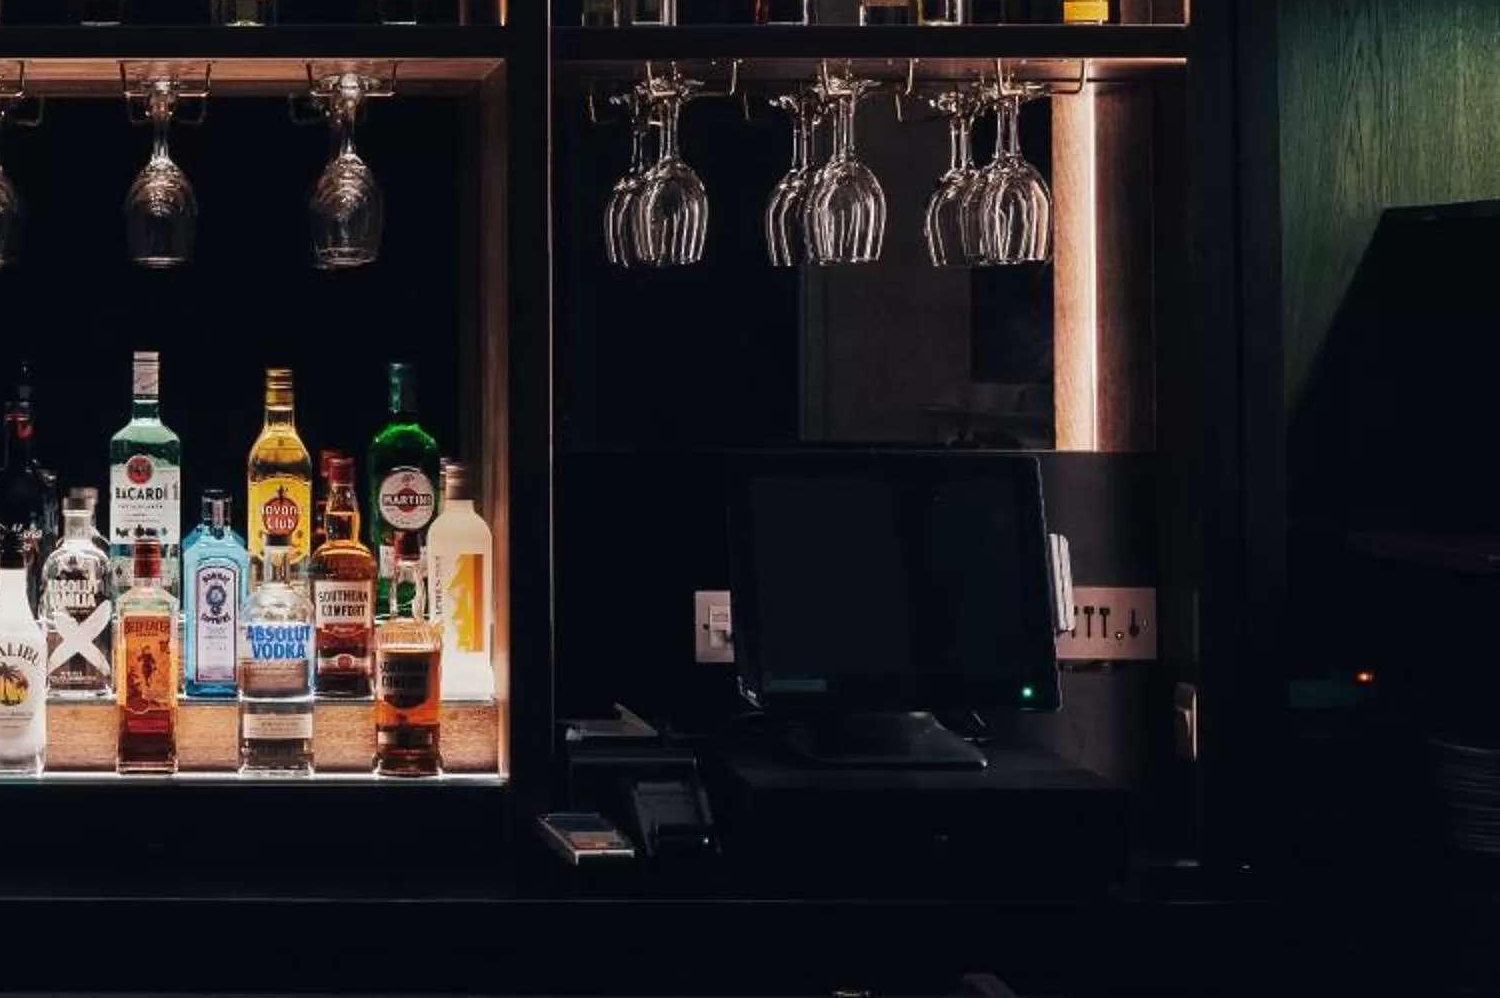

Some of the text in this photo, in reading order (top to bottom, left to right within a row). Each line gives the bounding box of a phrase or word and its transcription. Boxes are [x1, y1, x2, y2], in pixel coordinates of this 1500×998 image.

[321, 604, 366, 617] COMFORT
[246, 624, 311, 641] ABSOLUT
[251, 642, 306, 659] VODKA
